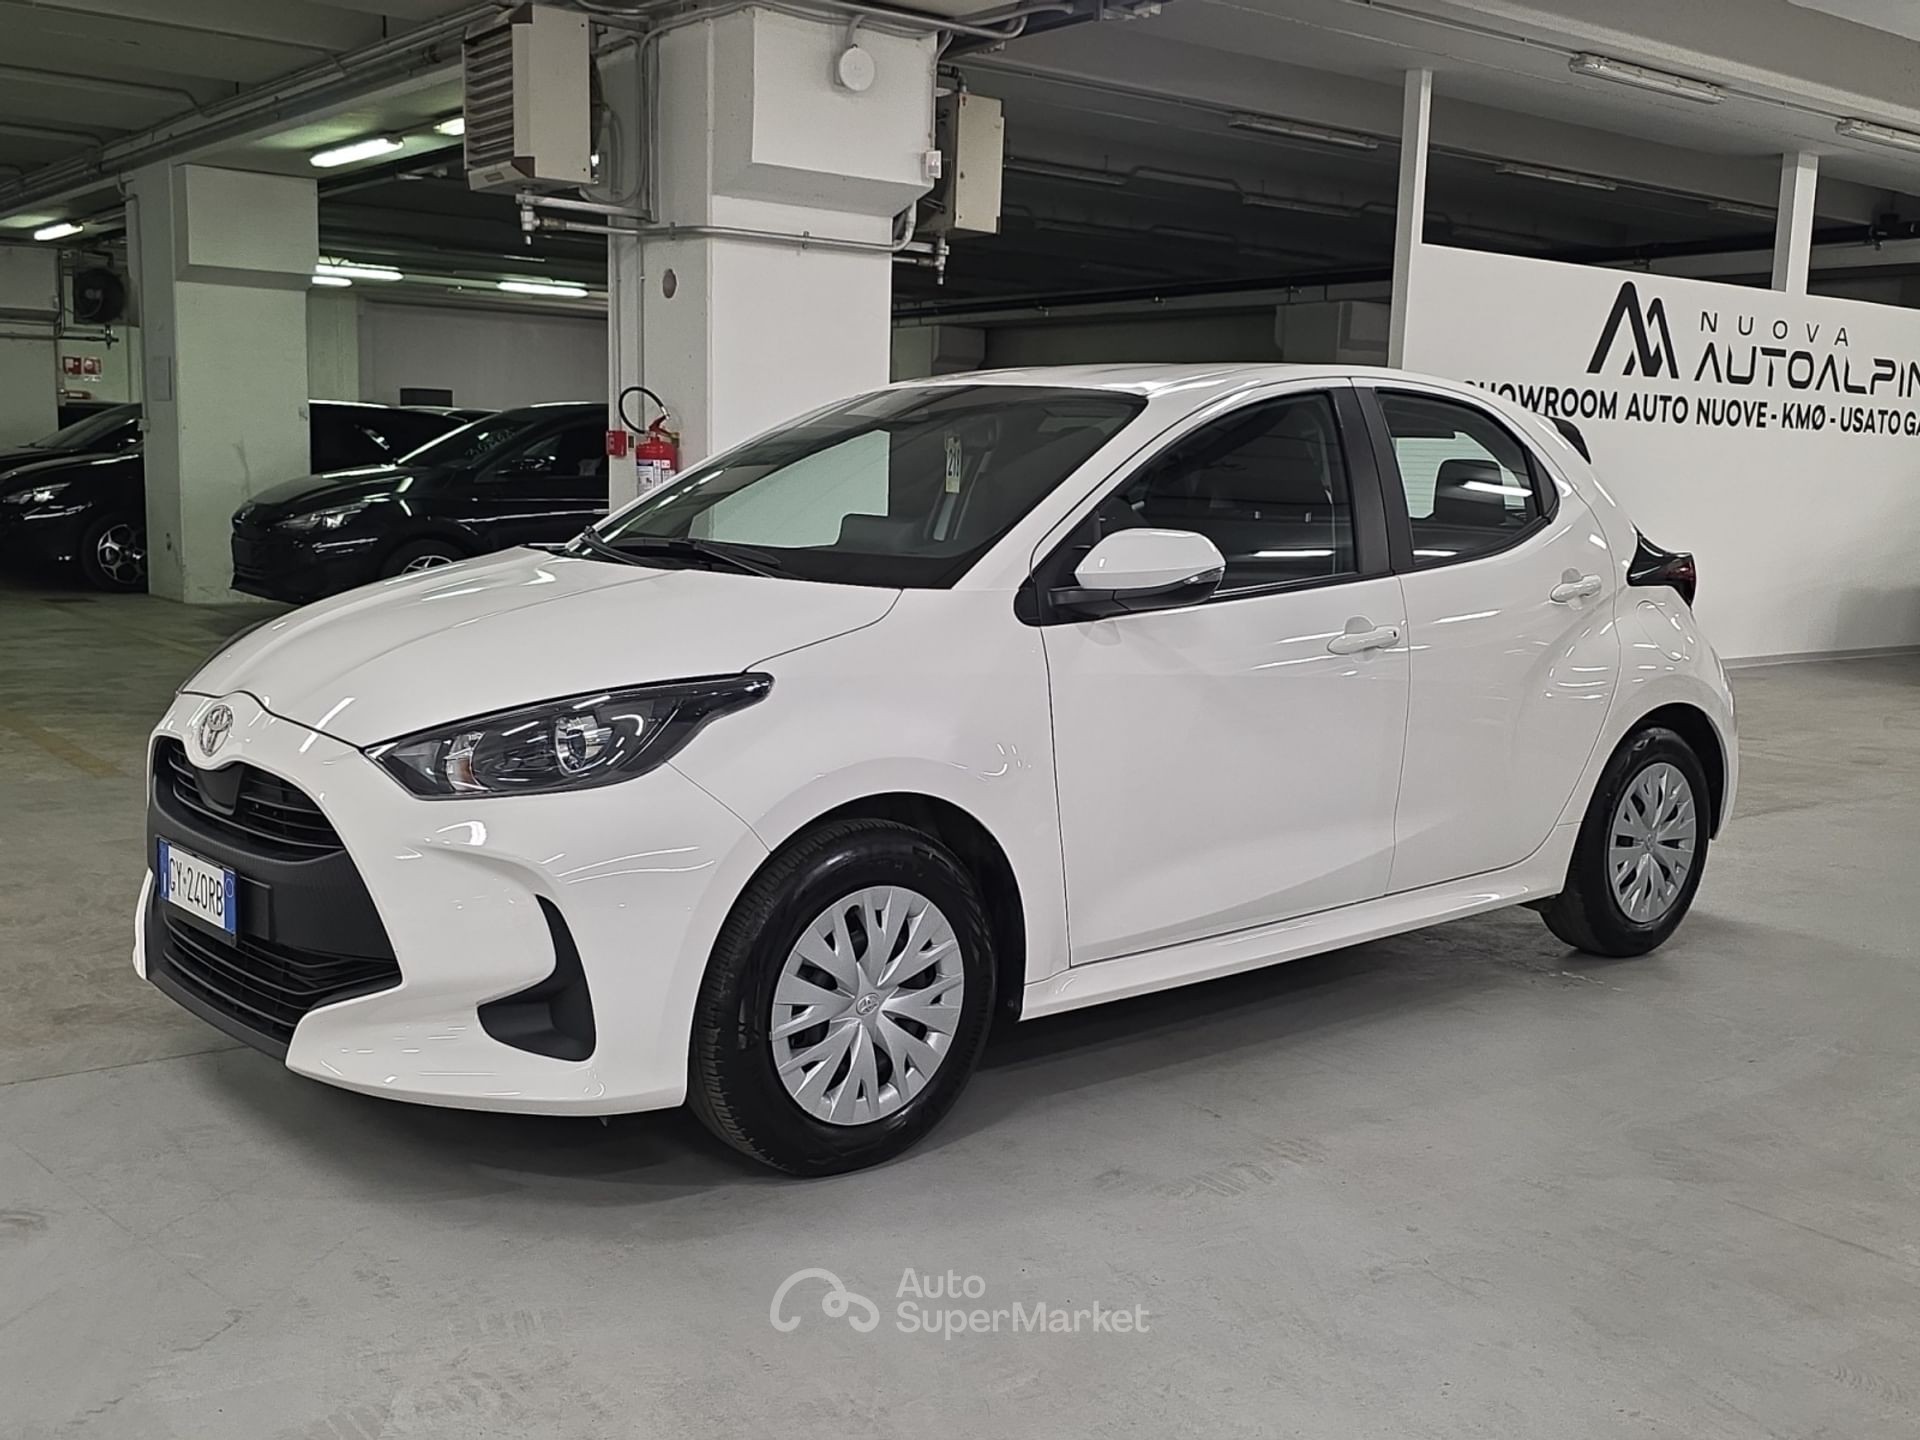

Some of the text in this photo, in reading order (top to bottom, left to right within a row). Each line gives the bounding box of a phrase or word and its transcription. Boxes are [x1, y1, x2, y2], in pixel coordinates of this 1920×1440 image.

[1700, 311, 1849, 346] NUOVA
[1464, 380, 1618, 420] OWROOM
[1624, 393, 1689, 424] AUTO
[1840, 406, 1901, 435] USATO
